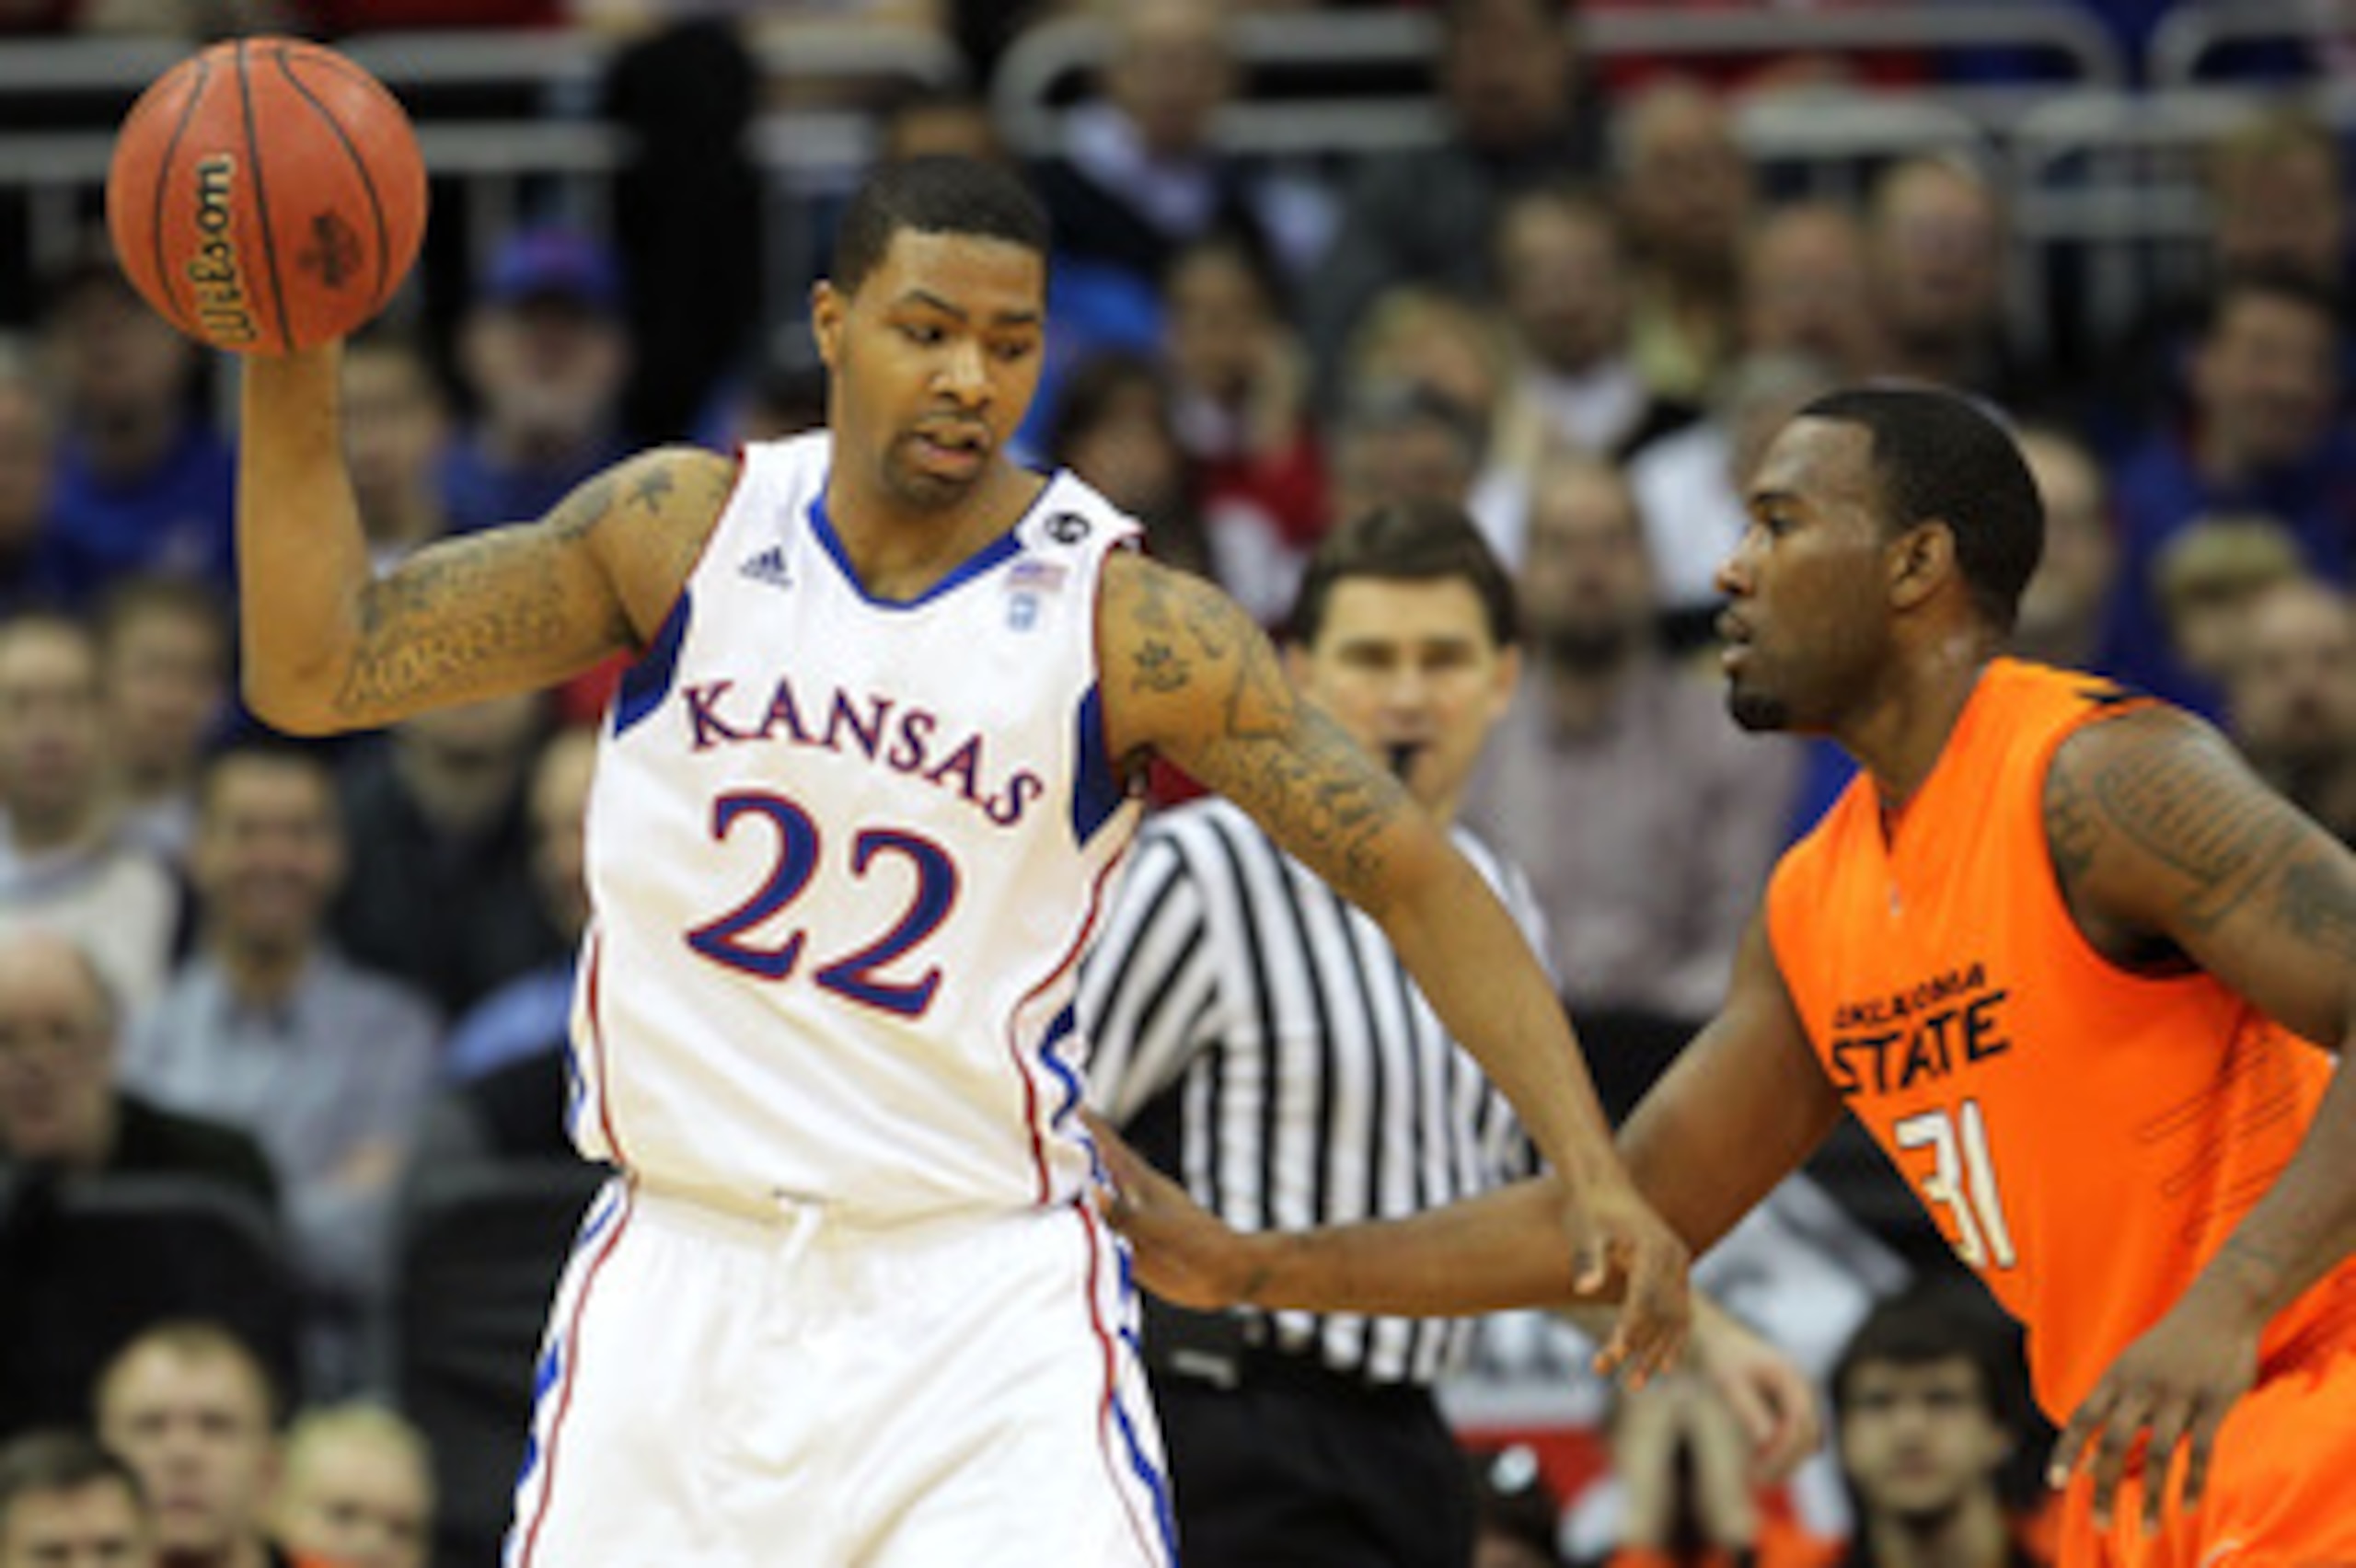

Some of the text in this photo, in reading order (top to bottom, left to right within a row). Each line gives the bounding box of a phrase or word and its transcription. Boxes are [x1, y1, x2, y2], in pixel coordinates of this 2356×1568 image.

[188, 153, 258, 341] Wilson
[682, 676, 1044, 826] KANSAS
[685, 787, 960, 1018] 22
[1831, 990, 2009, 1096] STATE
[1894, 1099, 2016, 1268] 31
